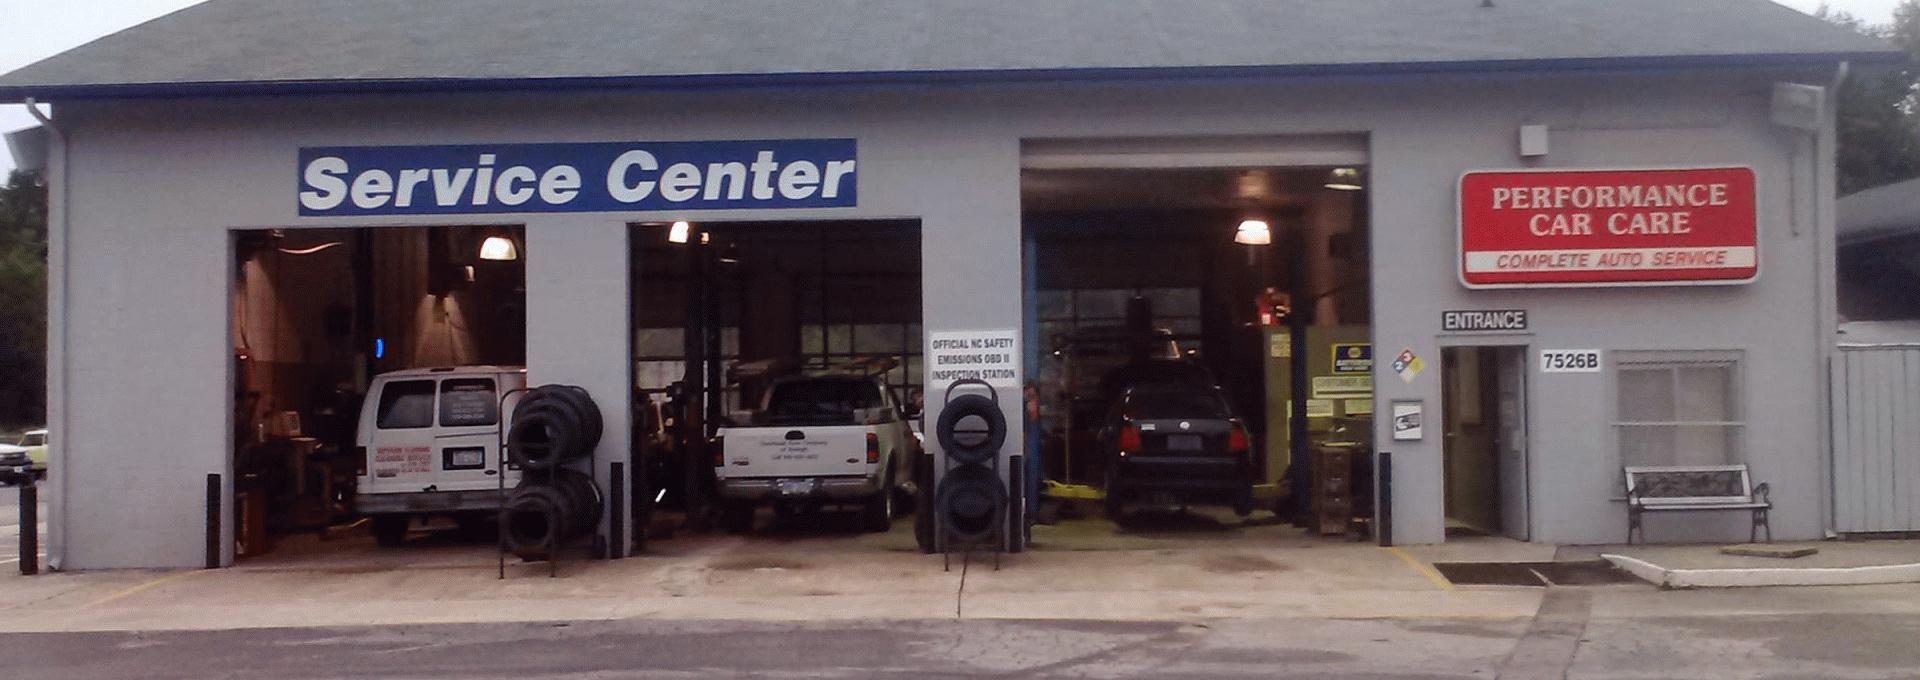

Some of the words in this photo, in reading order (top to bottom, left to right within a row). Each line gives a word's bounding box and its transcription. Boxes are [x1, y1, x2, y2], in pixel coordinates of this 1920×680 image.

[300, 153, 582, 211] Service
[607, 149, 856, 204] Center
[1491, 183, 1729, 210] PERFORMANCE
[1529, 213, 1593, 236] CAR
[1607, 212, 1692, 235] CARE
[1497, 253, 1589, 269] COMPLETE
[1597, 252, 1643, 267] AUTO
[1653, 250, 1728, 266] SERVICE
[1444, 311, 1525, 329] ENTRANCE
[933, 340, 968, 349] OFFICIAL
[971, 339, 982, 348] NC
[984, 338, 1013, 348] SAFETY
[937, 355, 982, 364] EMISSIONS
[985, 354, 1001, 363] OBD
[1395, 361, 1404, 370] 2
[1543, 353, 1599, 368] 7526B
[932, 370, 980, 380] INSPECTION
[983, 369, 1015, 379] STATION
